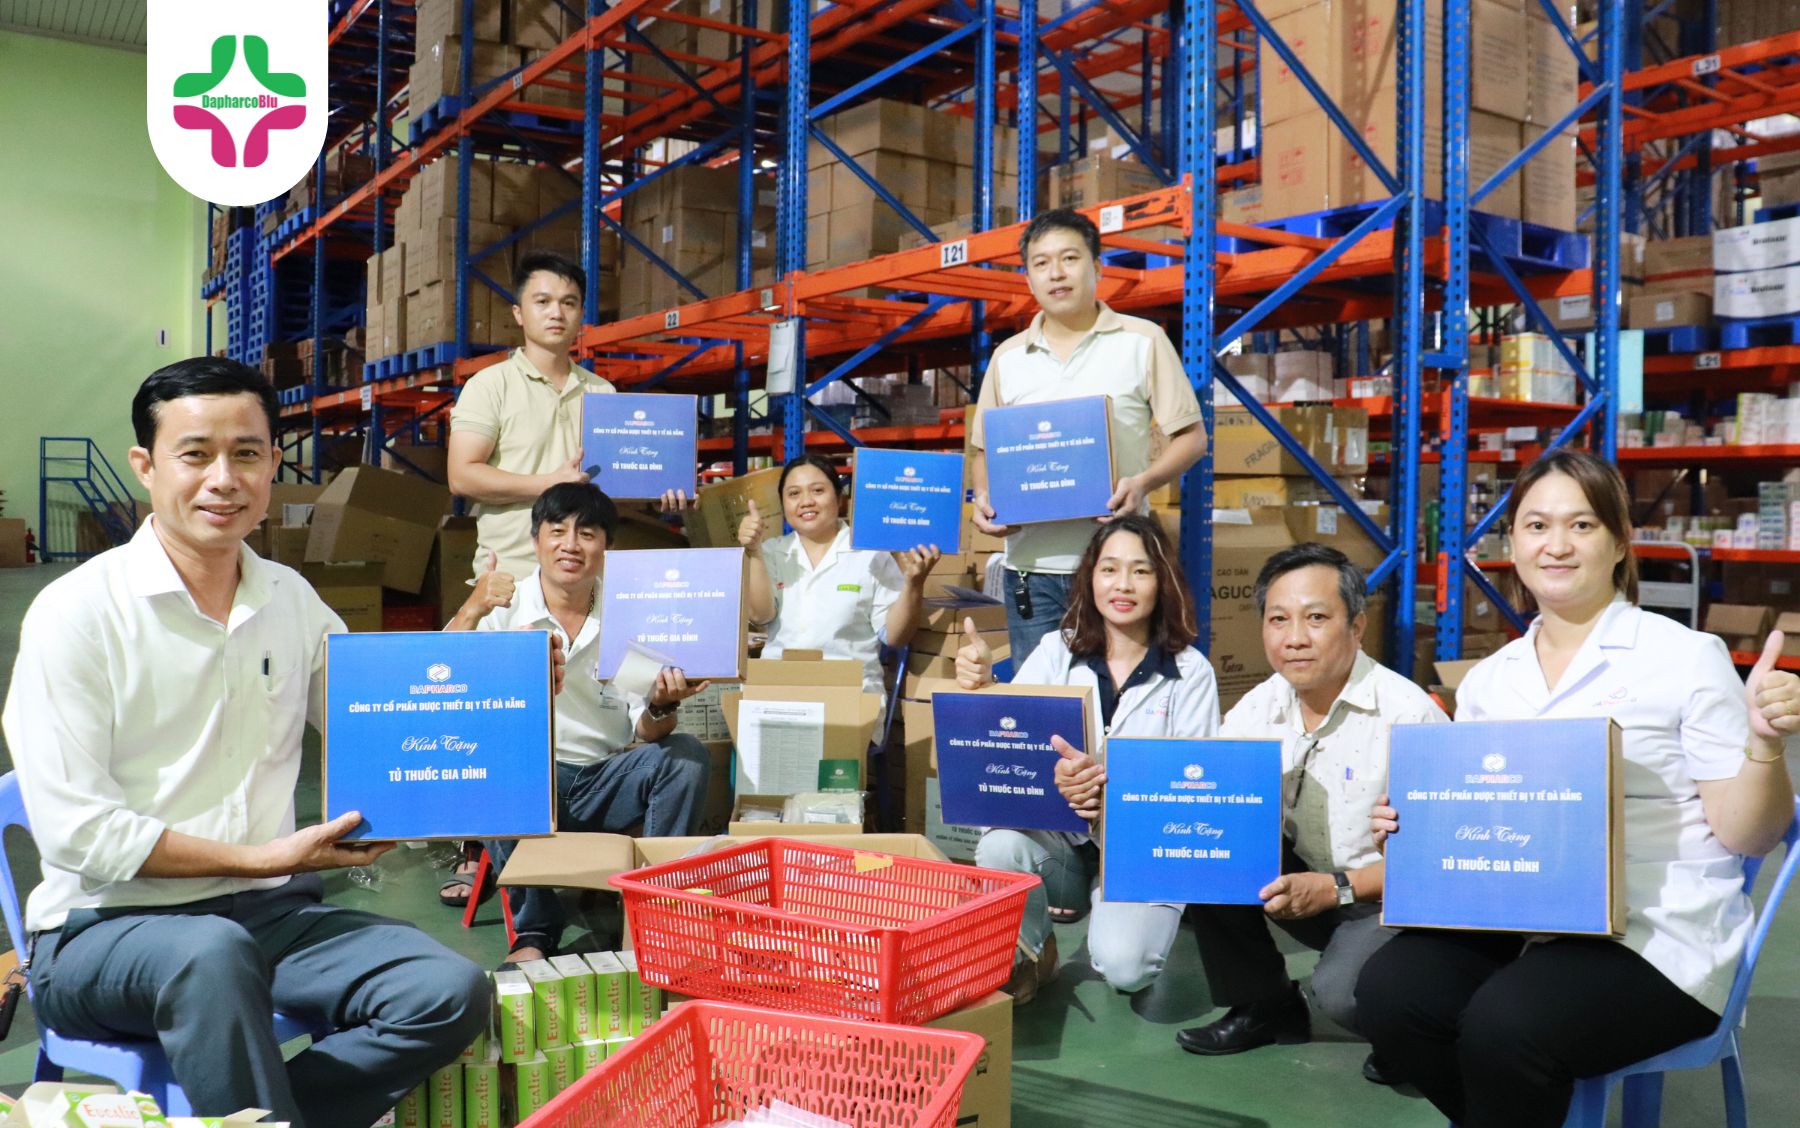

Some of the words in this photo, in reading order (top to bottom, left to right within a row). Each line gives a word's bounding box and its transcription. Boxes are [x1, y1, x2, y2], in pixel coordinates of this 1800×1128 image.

[668, 313, 677, 326] 22
[349, 702, 370, 712] CÔNG
[372, 703, 381, 712] TY
[476, 701, 480, 709] Y
[482, 697, 491, 709] TẾ
[402, 736, 438, 752] Kính
[440, 735, 478, 755] Tặng
[389, 767, 401, 781] TỦ
[405, 766, 439, 781] THUỐC
[442, 770, 458, 780] GIA
[462, 765, 487, 779] ĐÌNH
[545, 985, 558, 1040] Eucalic
[576, 982, 588, 1035] Eucalic
[608, 978, 620, 1032] Eucalic
[512, 1000, 525, 1056] Eucalic
